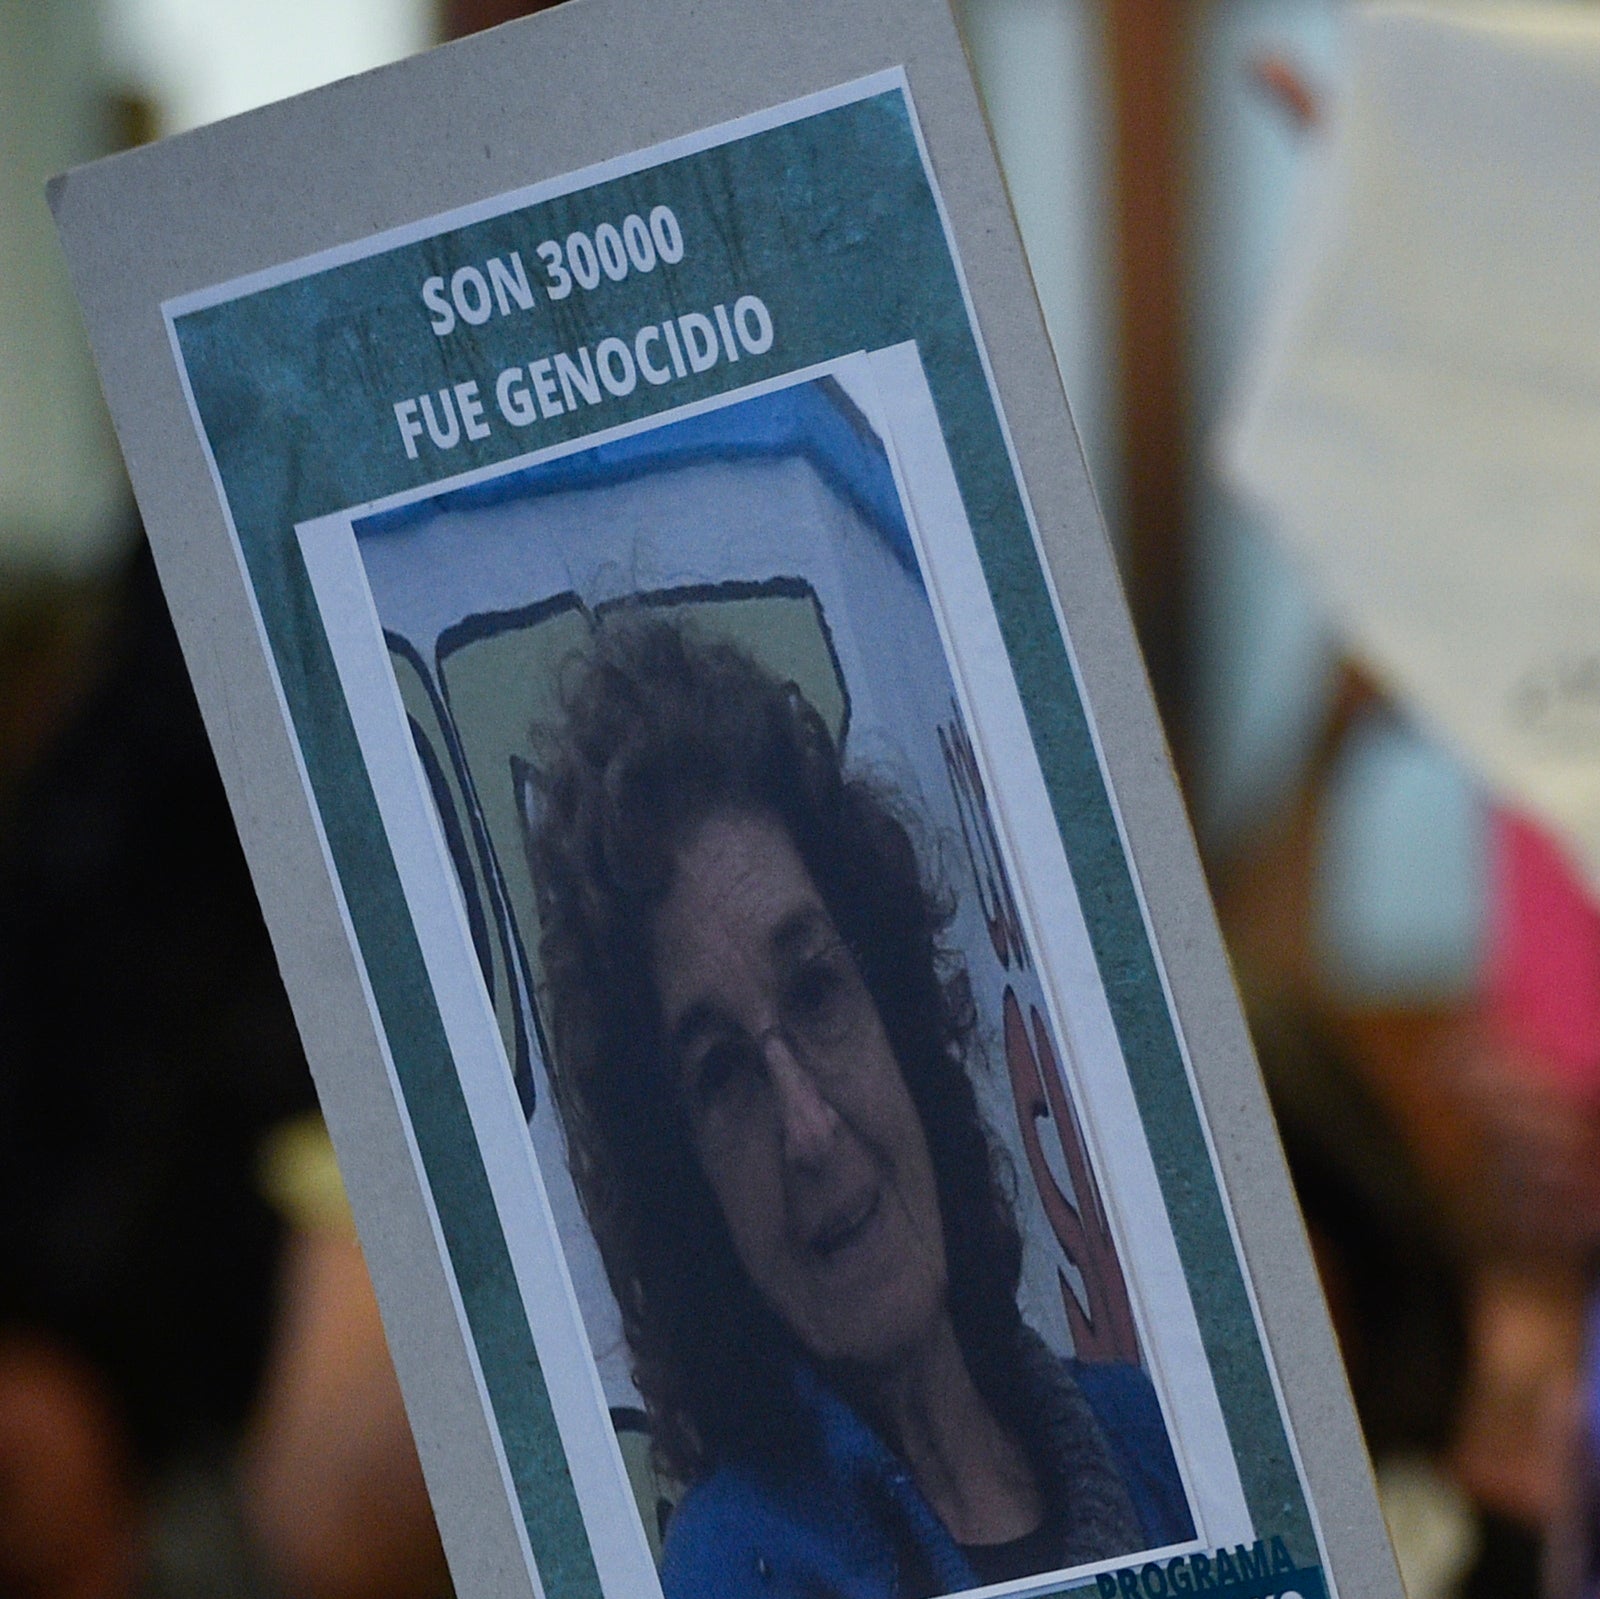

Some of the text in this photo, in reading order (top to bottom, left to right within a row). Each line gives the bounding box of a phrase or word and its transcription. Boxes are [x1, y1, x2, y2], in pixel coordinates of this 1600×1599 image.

[421, 204, 686, 336] SON 30000
[392, 294, 775, 461] FUE GENOCIDIO
